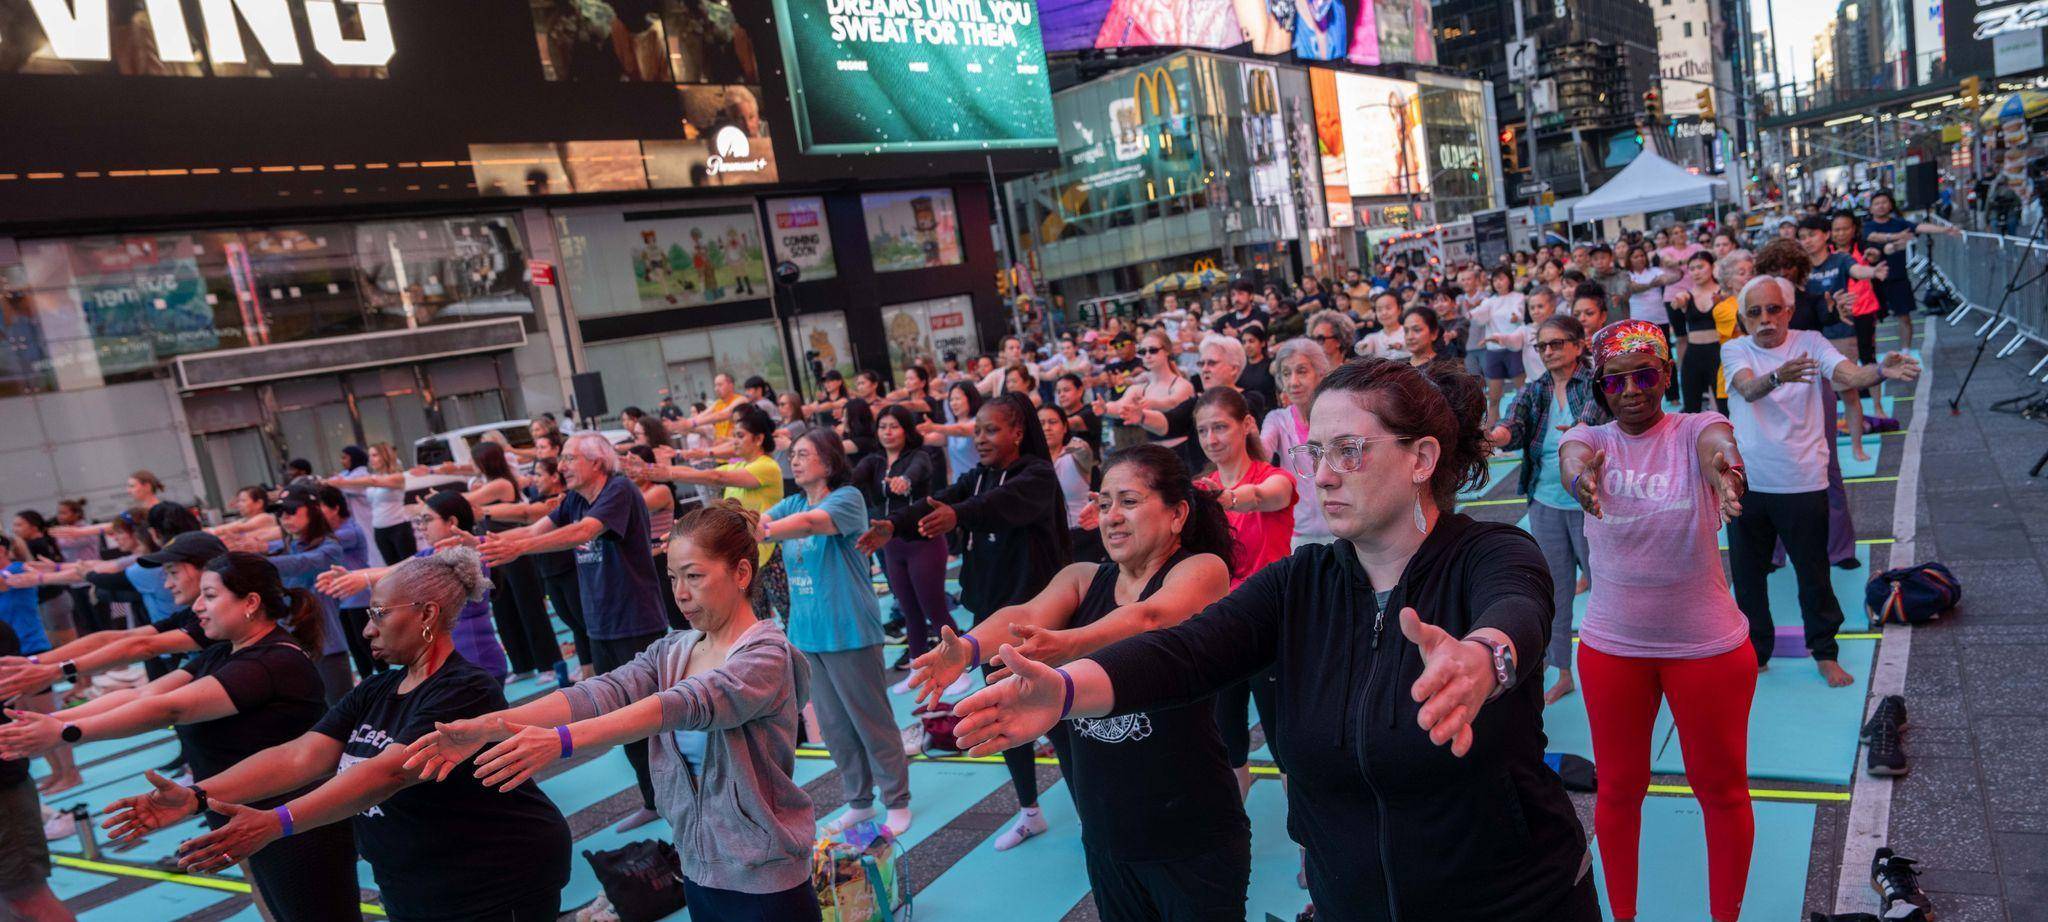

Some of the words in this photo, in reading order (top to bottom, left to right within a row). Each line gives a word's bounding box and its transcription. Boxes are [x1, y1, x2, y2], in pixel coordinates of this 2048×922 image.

[827, 0, 924, 20] DREAMS
[926, 0, 989, 22] UNTIL
[988, 0, 1032, 26] YOU
[829, 15, 908, 43] SWEAT
[912, 18, 958, 46] FOR
[958, 21, 1019, 48] THEM
[783, 233, 820, 248] COMING
[1603, 468, 1670, 501] oke
